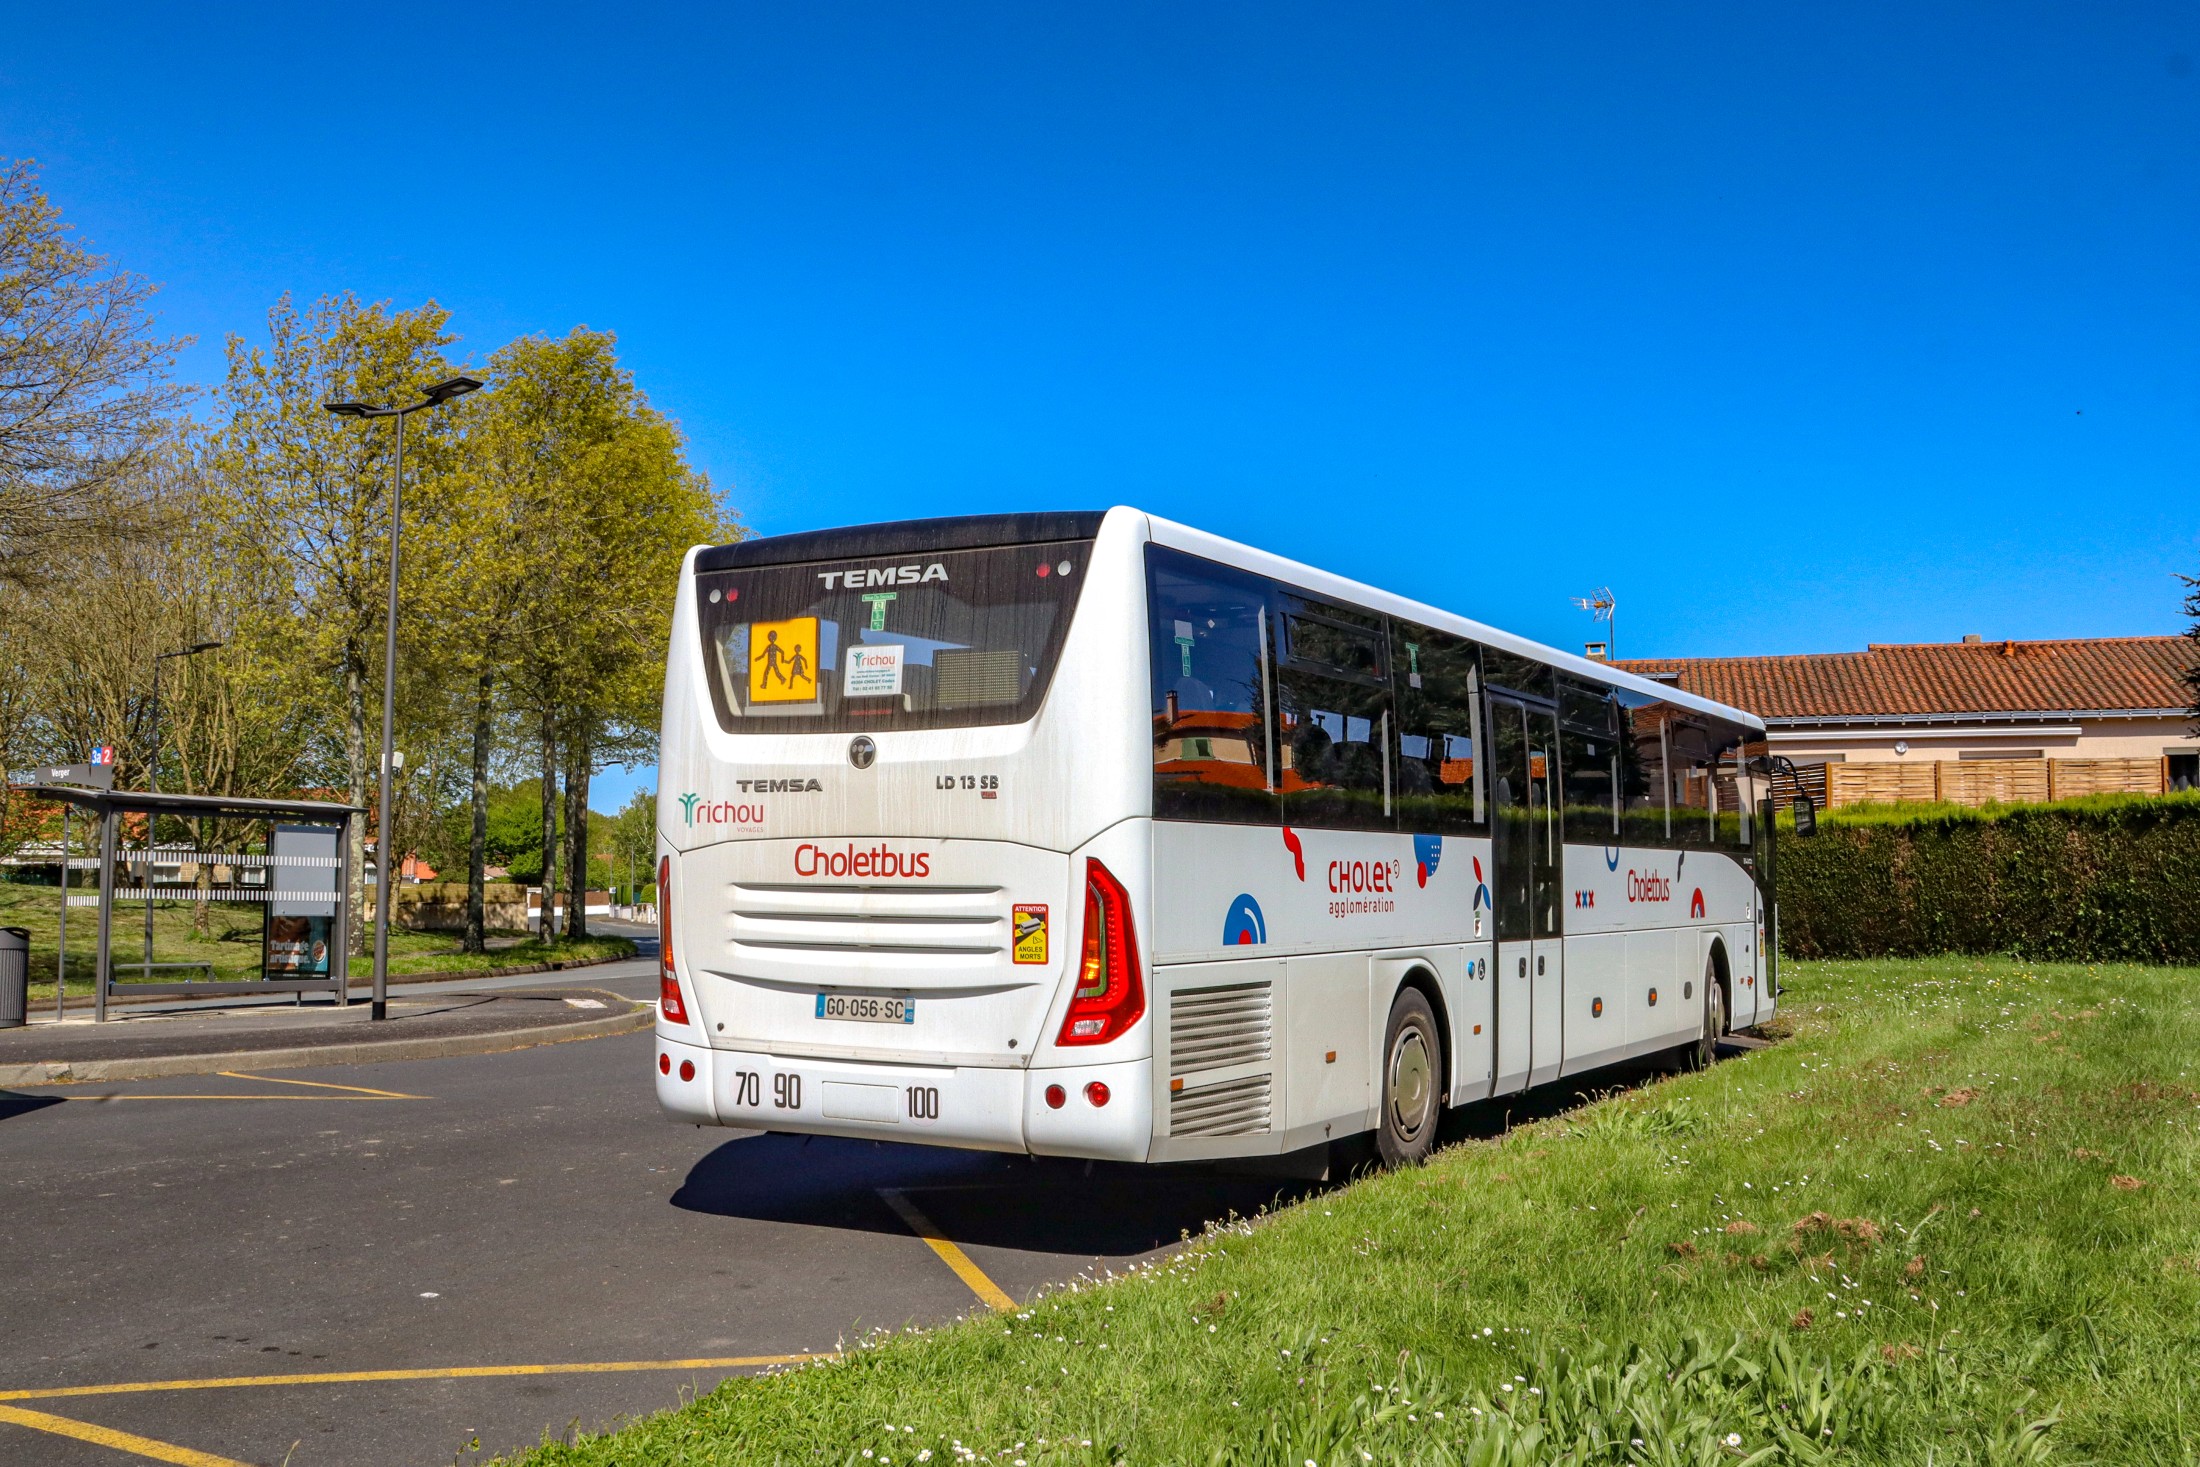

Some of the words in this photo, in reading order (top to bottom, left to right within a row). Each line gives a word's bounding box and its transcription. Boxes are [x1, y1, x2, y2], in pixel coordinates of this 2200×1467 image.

[817, 563, 949, 590] TEMSA
[92, 749, 101, 764] 3a
[103, 749, 111, 763] 2
[51, 768, 70, 778] Verger
[736, 778, 823, 793] TEMSA
[936, 775, 956, 790] LD
[960, 775, 976, 790] 13
[980, 775, 999, 790] SB
[794, 842, 930, 878] Choletbus
[1627, 868, 1671, 903] Choletbus
[1328, 896, 1395, 919] agglomération
[735, 1071, 760, 1107] 70
[774, 1072, 801, 1110] 90
[906, 1086, 939, 1120] 100
